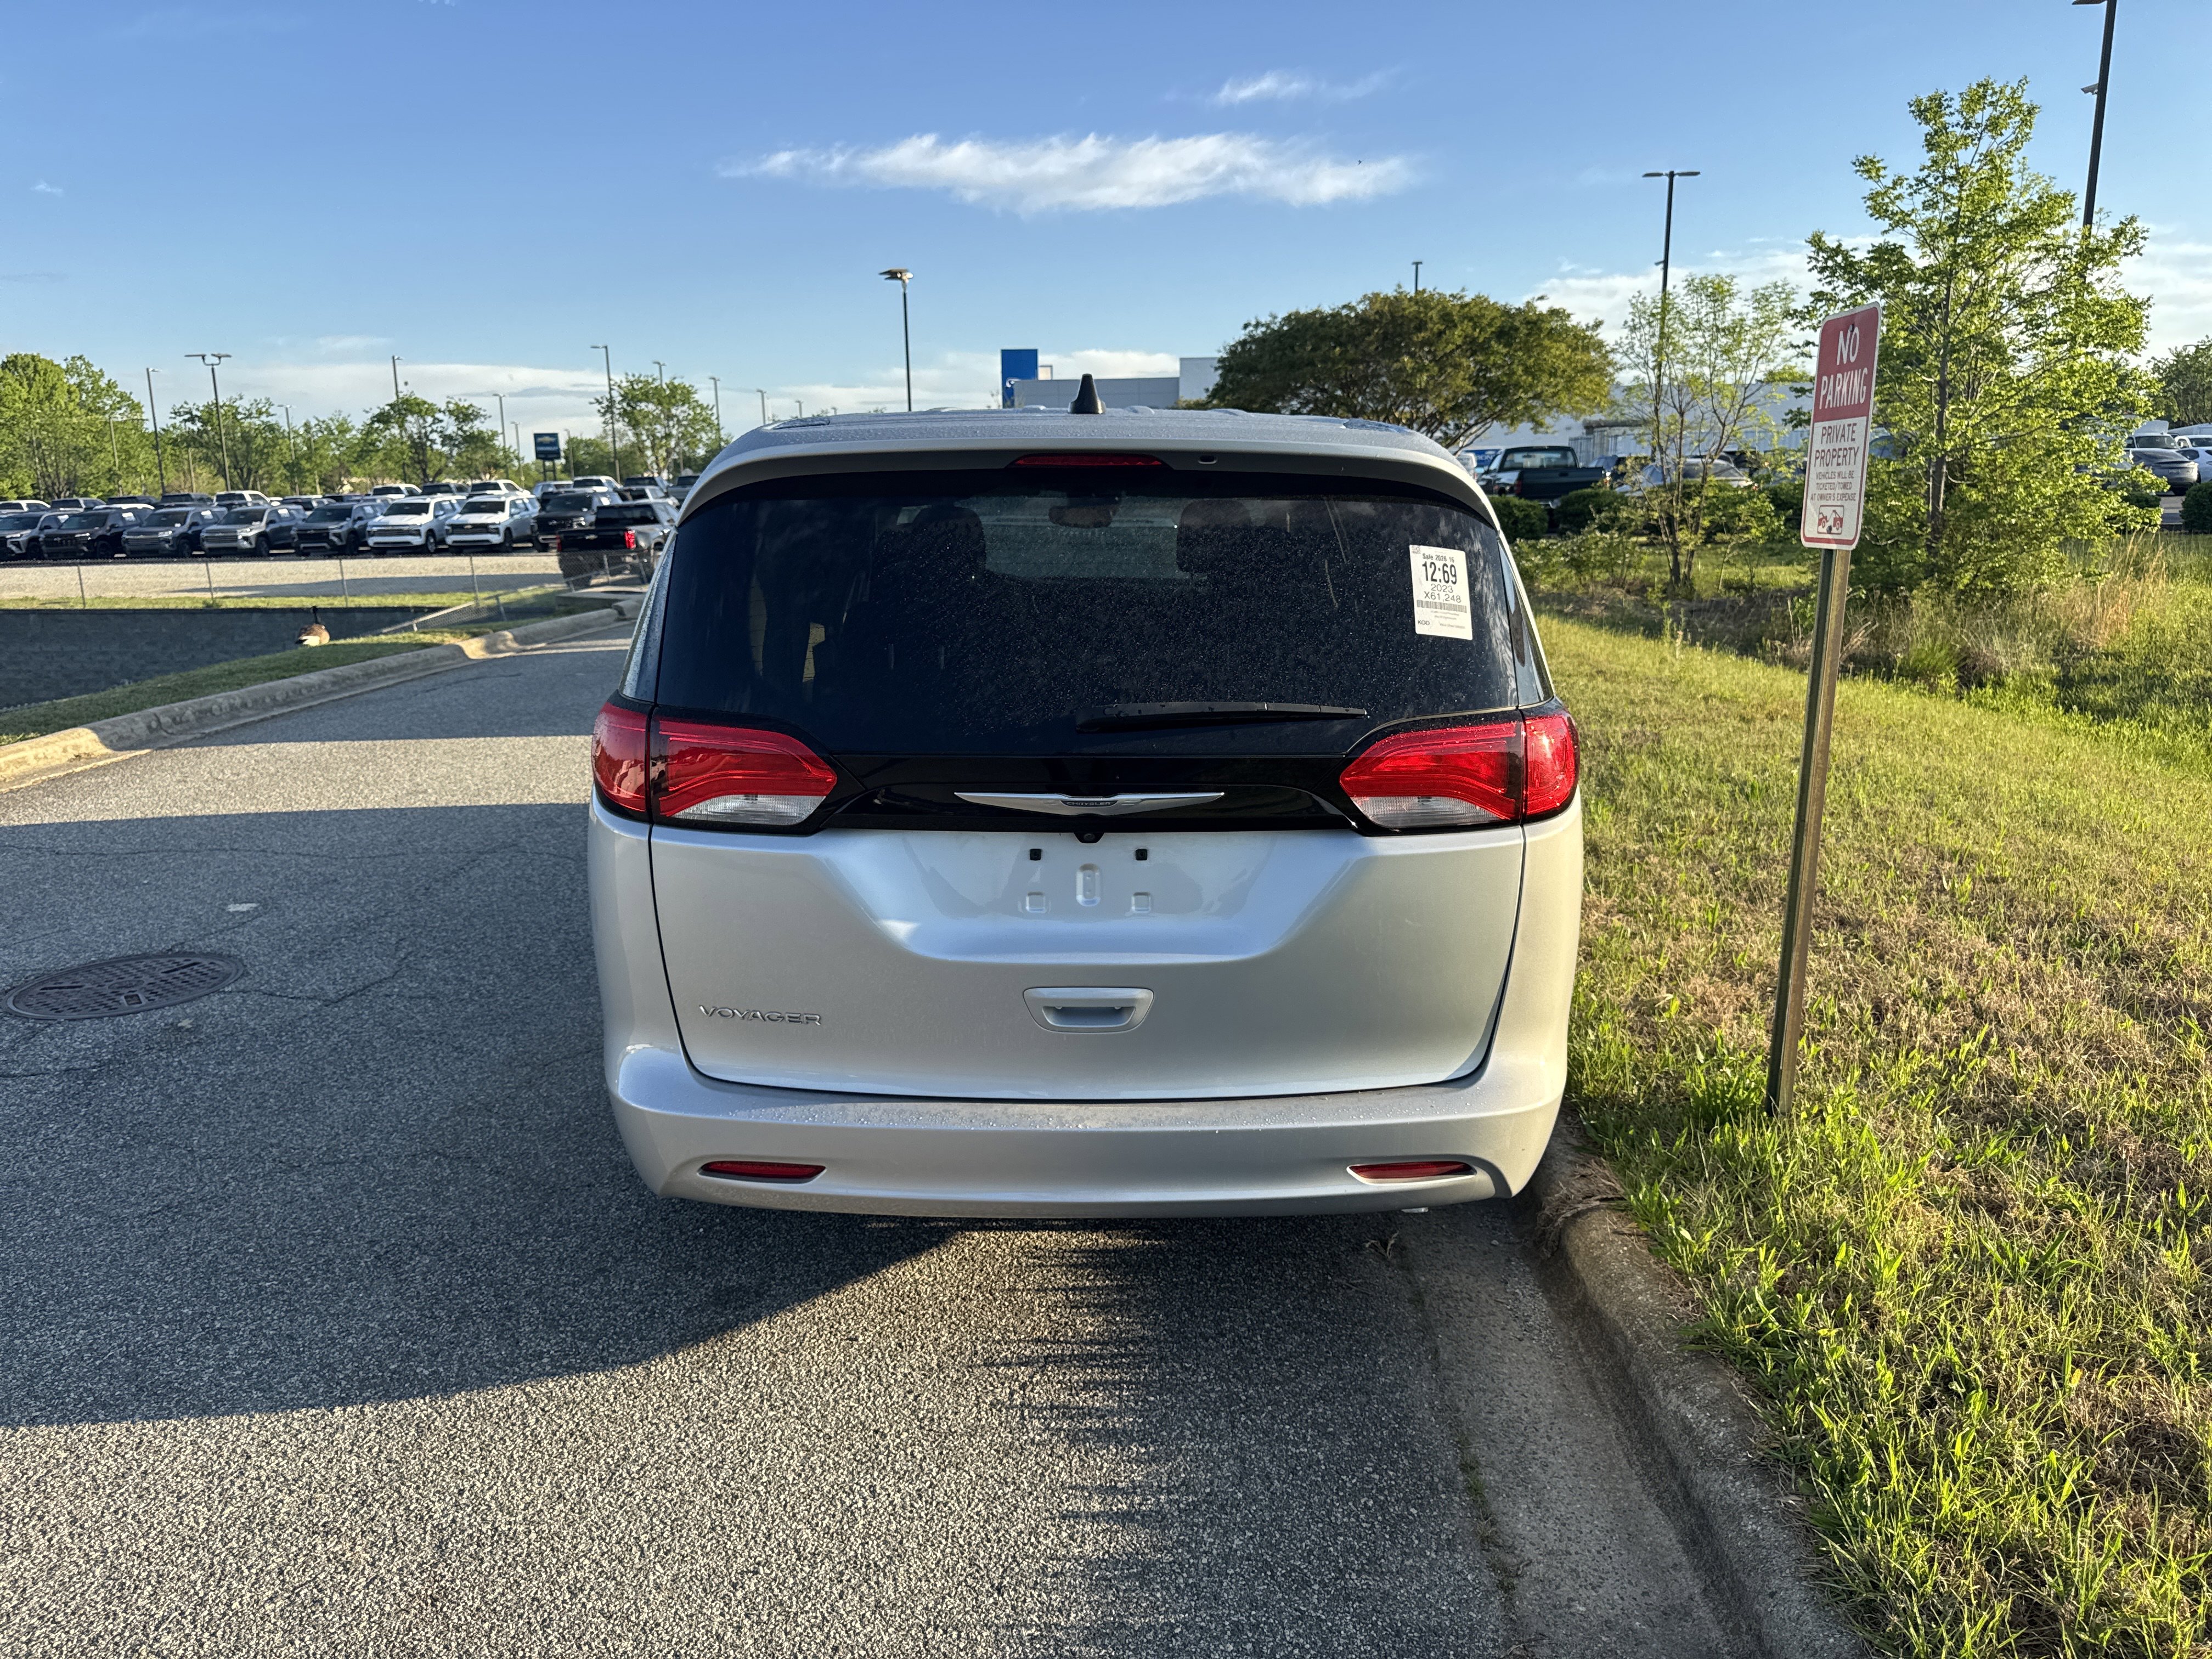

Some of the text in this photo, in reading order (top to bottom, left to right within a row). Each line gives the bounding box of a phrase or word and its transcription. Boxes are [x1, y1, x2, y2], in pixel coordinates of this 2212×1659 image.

[1836, 326, 1859, 366] NO
[1819, 367, 1868, 410] PARKING
[1820, 422, 1857, 444] PRIVATE
[1814, 446, 1860, 467] PROPERTY
[1816, 470, 1854, 479] VEHICLES WILL BE
[1810, 492, 1857, 501] AT OWNER'S EXPENSE
[1422, 552, 1434, 561] Sale
[1422, 561, 1457, 585] 12:69
[1423, 590, 1462, 603] X61,248
[1430, 583, 1454, 594] 2023
[698, 1005, 822, 1025] VOYAGER
